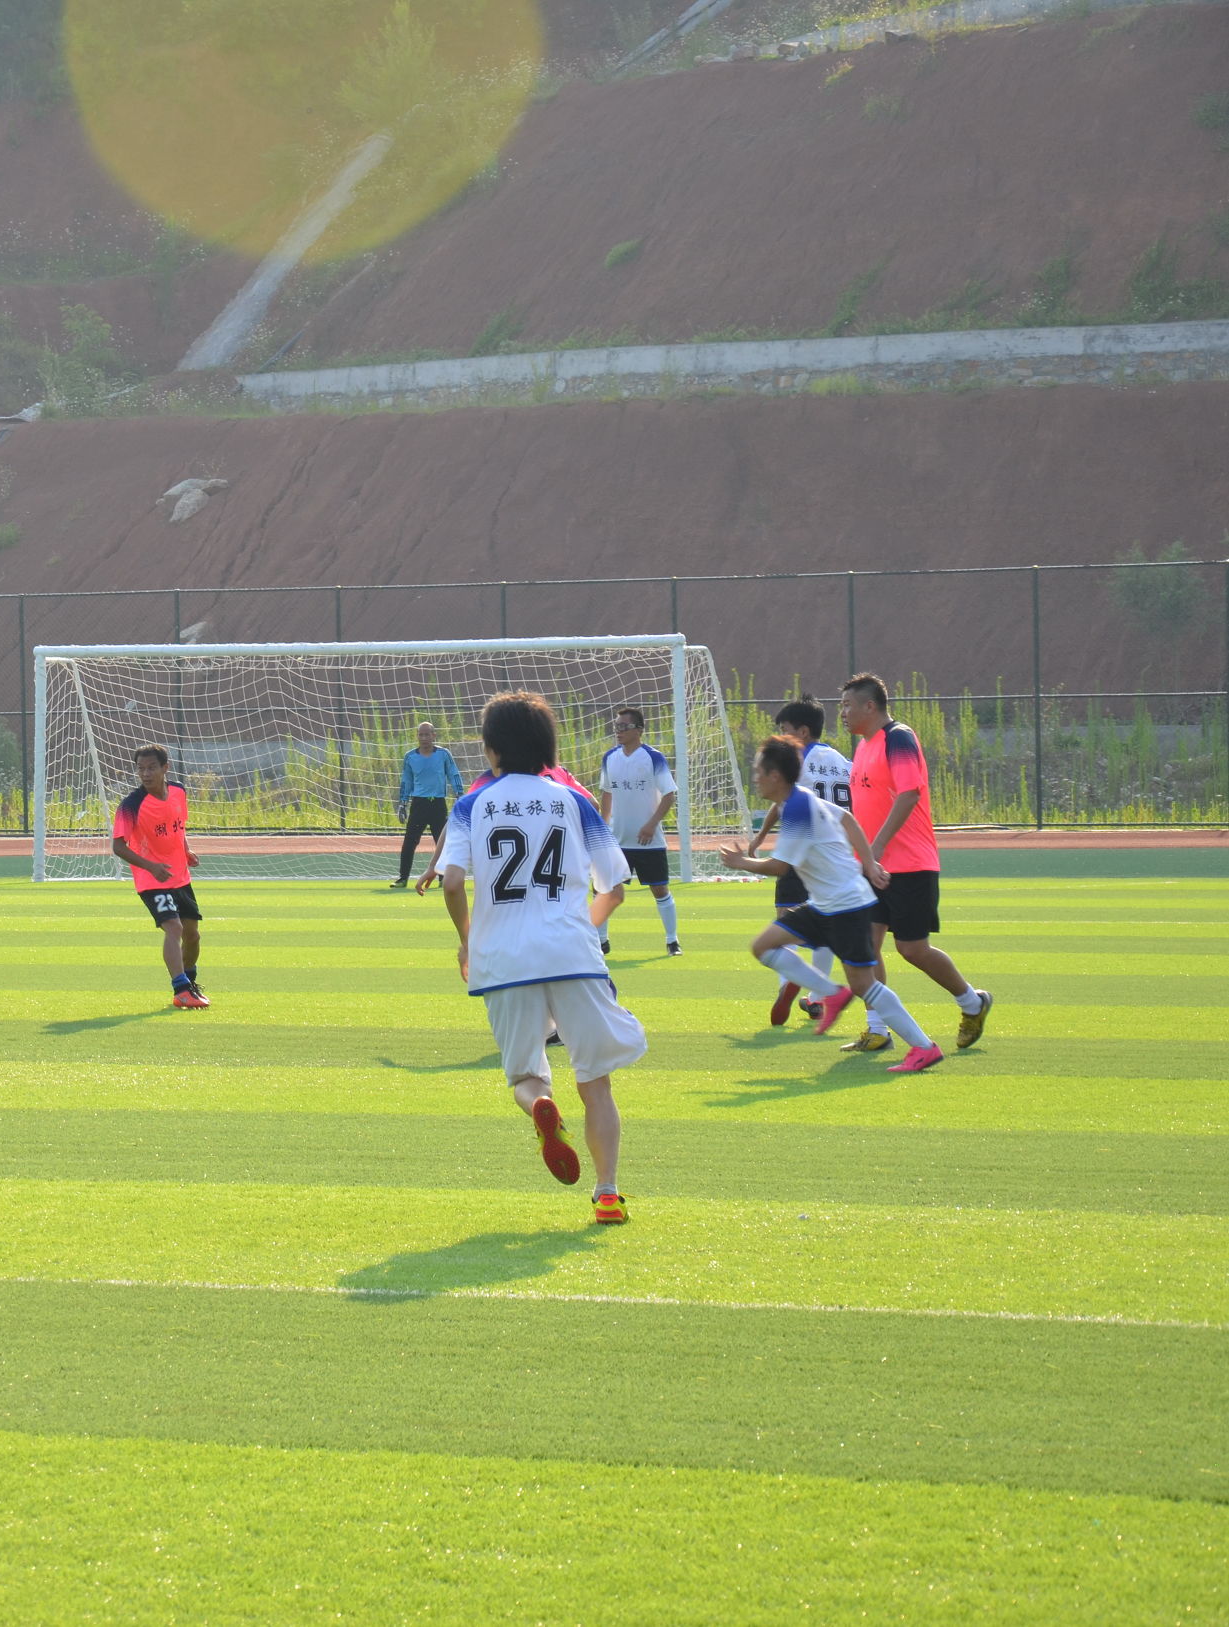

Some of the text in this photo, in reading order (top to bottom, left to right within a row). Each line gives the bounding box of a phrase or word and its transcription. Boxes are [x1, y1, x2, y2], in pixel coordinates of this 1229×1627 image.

[483, 800, 565, 820] 卓越旅游
[486, 825, 566, 905] 24
[154, 893, 177, 912] 23
